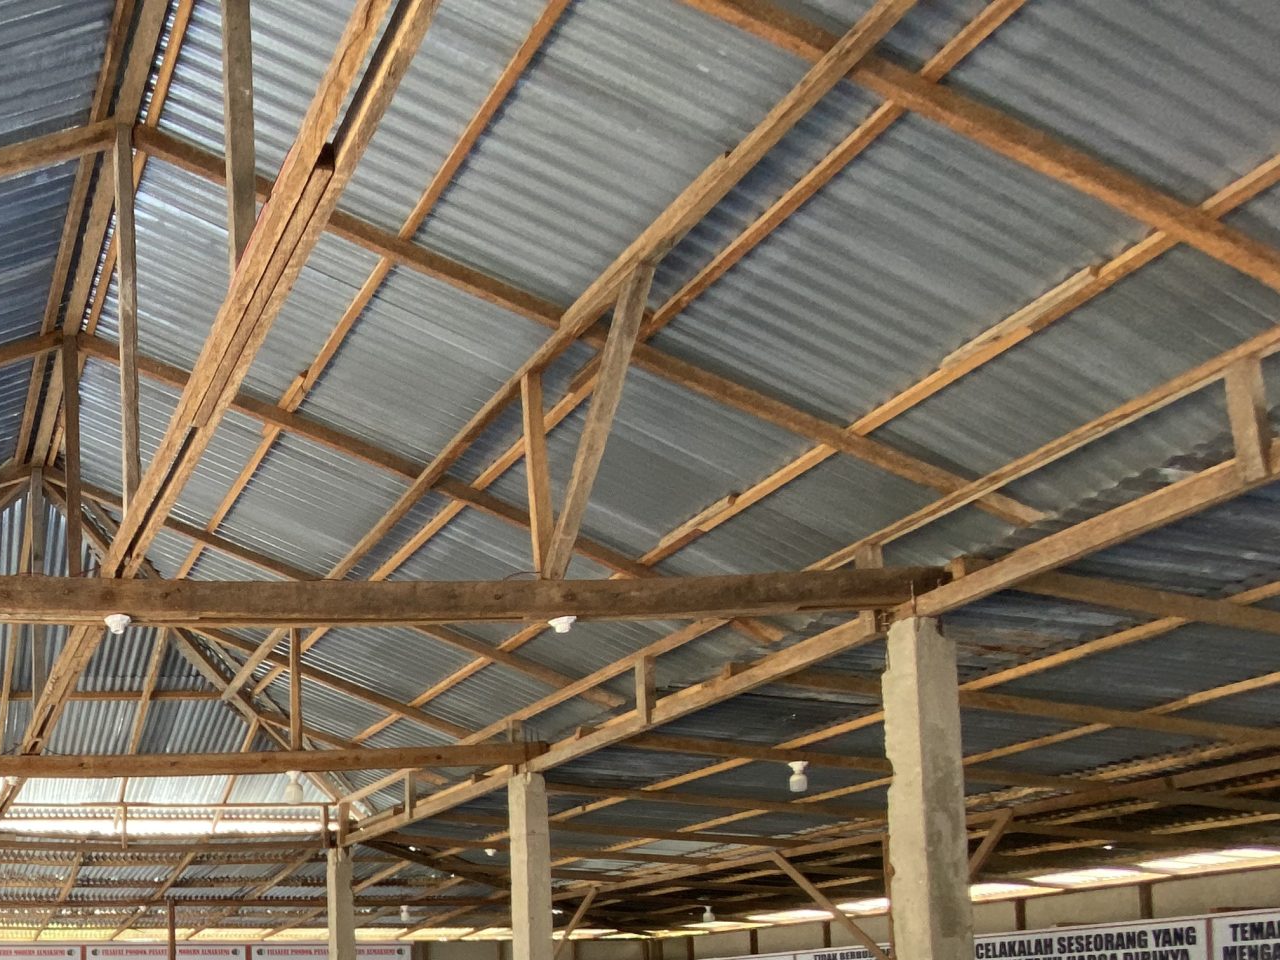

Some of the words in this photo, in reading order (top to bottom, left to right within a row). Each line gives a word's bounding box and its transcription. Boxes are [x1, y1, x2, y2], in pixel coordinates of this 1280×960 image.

[976, 936, 1053, 960] CELAKALAH
[1057, 930, 1148, 954] SESEORANG
[1152, 926, 1197, 948] YANG
